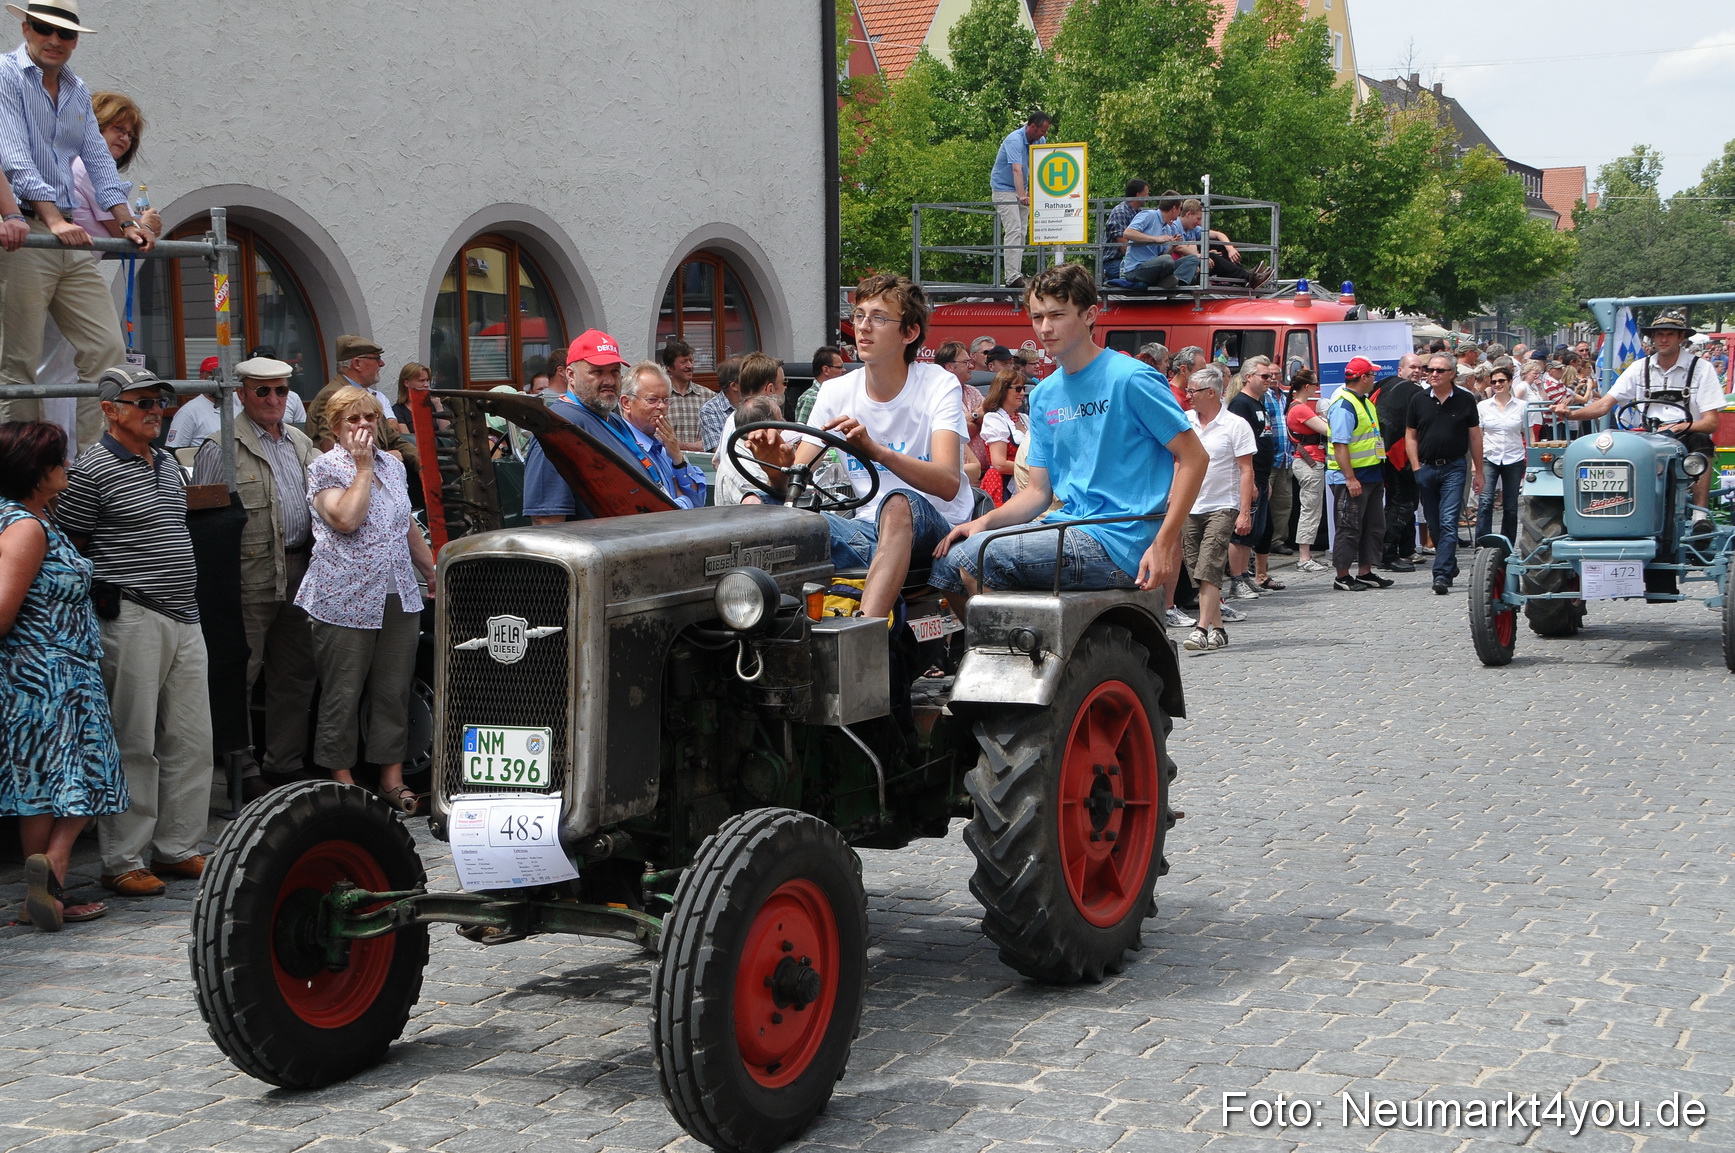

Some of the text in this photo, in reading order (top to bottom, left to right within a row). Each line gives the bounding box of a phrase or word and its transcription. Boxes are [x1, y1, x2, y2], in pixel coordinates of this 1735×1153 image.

[1328, 344, 1356, 353] KOLLER
[1058, 399, 1109, 423] BILLABONG
[1589, 469, 1605, 479] NM
[1583, 480, 1624, 490] SP 777
[706, 558, 734, 572] DIESEL
[1610, 567, 1635, 578] 472
[494, 624, 520, 644] HELA
[493, 645, 520, 654] DIESEL
[478, 731, 505, 755] NM
[500, 758, 541, 783] 396
[500, 814, 544, 841] 485
